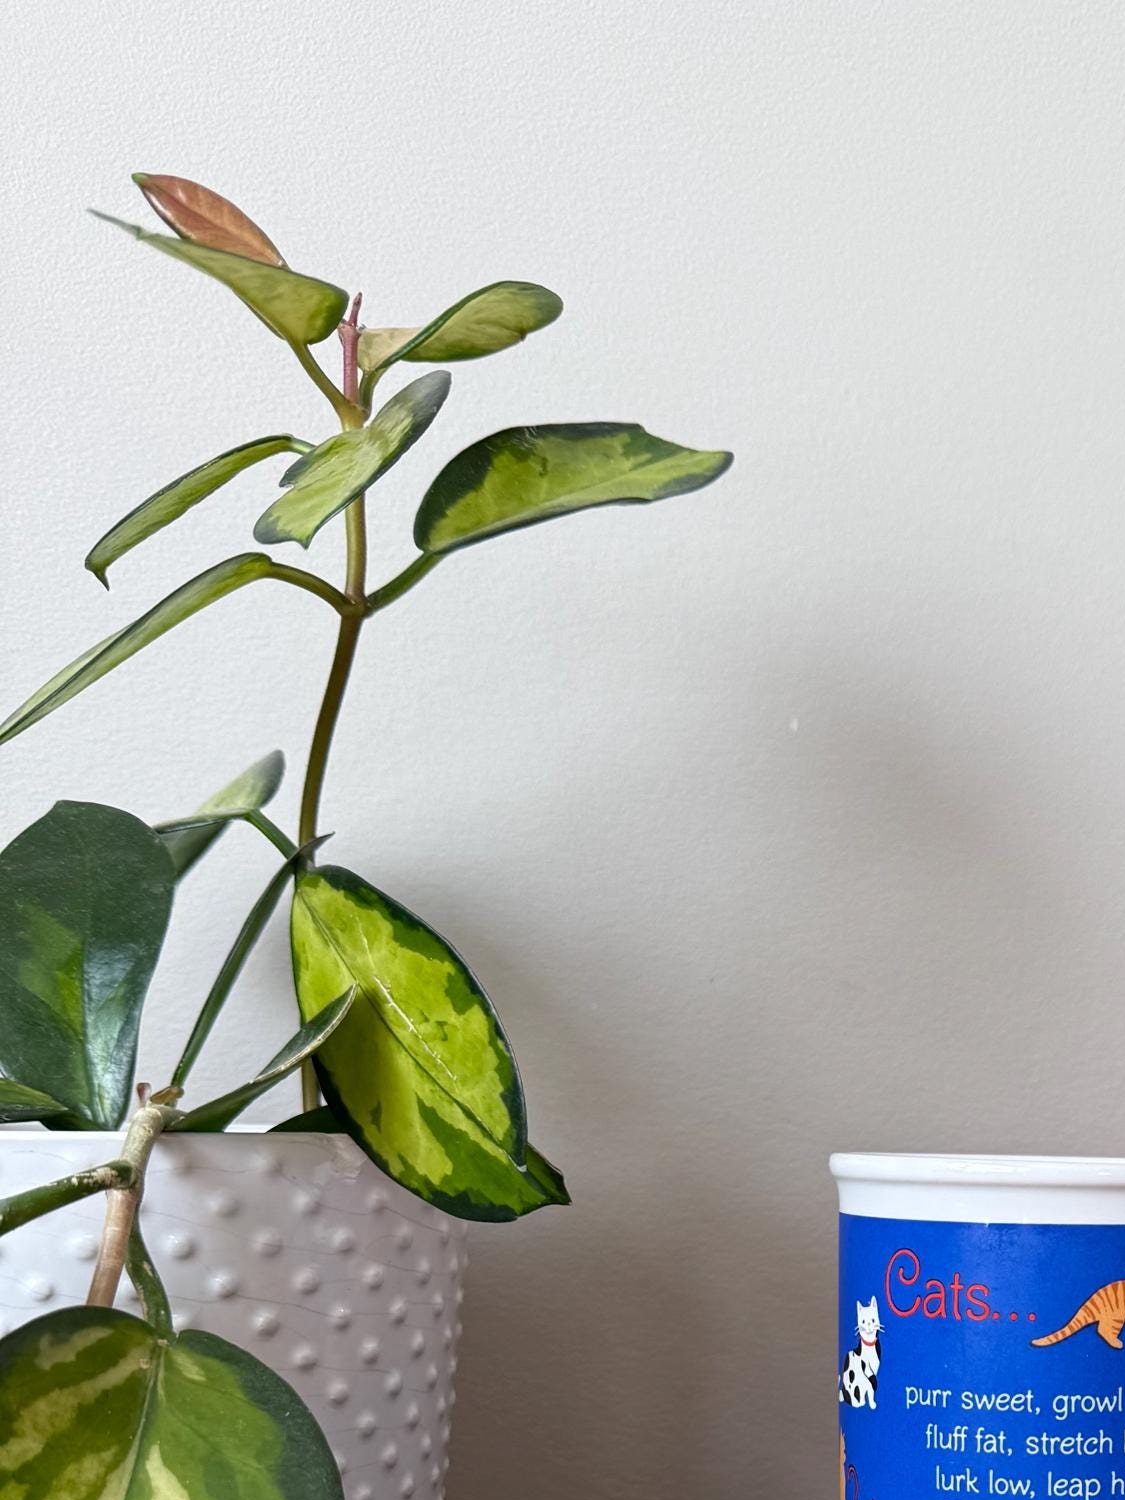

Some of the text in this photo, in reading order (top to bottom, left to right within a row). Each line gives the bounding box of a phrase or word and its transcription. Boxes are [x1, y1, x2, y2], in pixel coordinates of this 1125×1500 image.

[884, 1247, 1037, 1322] Cats...
[905, 1386, 952, 1409] purr
[961, 1389, 1041, 1415] sweet,
[1052, 1387, 1123, 1418] growl
[925, 1423, 969, 1452] fluff
[975, 1426, 1013, 1456] fat,
[1026, 1429, 1113, 1455] stretch
[936, 1465, 980, 1493] lurk
[989, 1469, 1035, 1499] low,
